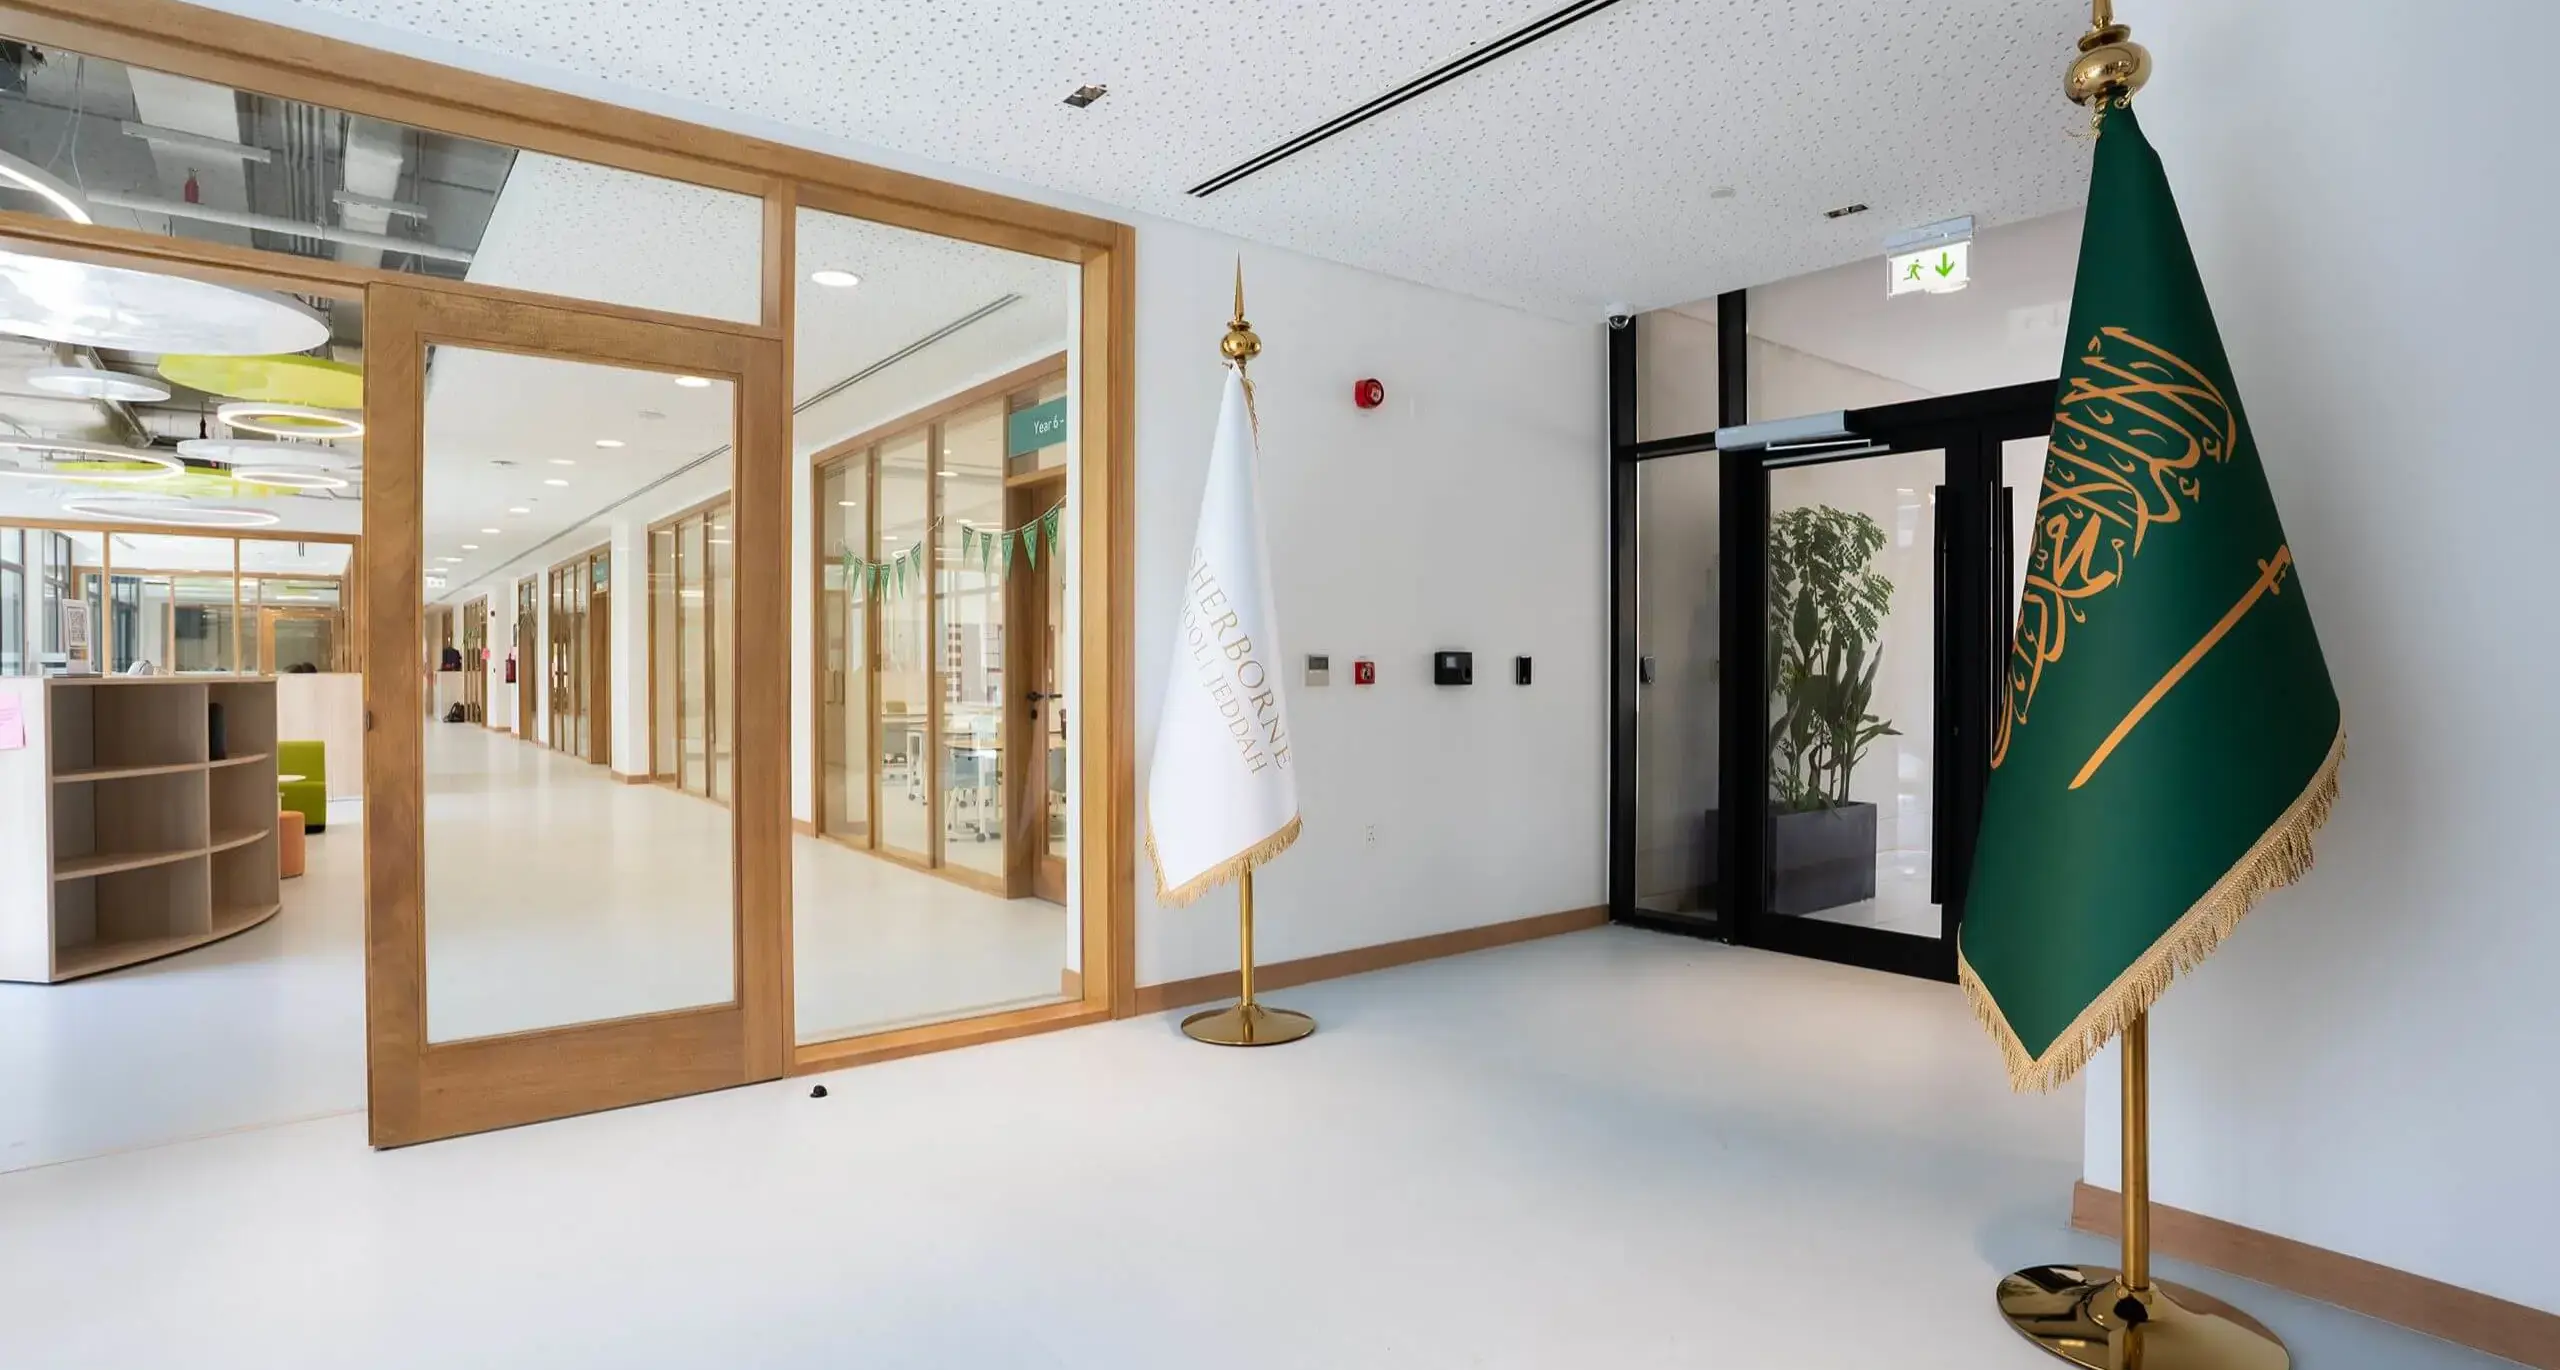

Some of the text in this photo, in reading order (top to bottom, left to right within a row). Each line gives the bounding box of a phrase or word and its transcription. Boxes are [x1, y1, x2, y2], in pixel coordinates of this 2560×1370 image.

[1033, 420, 1052, 435] Year
[1053, 414, 1059, 429] 6
[1190, 547, 1291, 769] SHERBORNE
[1203, 672, 1269, 775] JEDDAH
